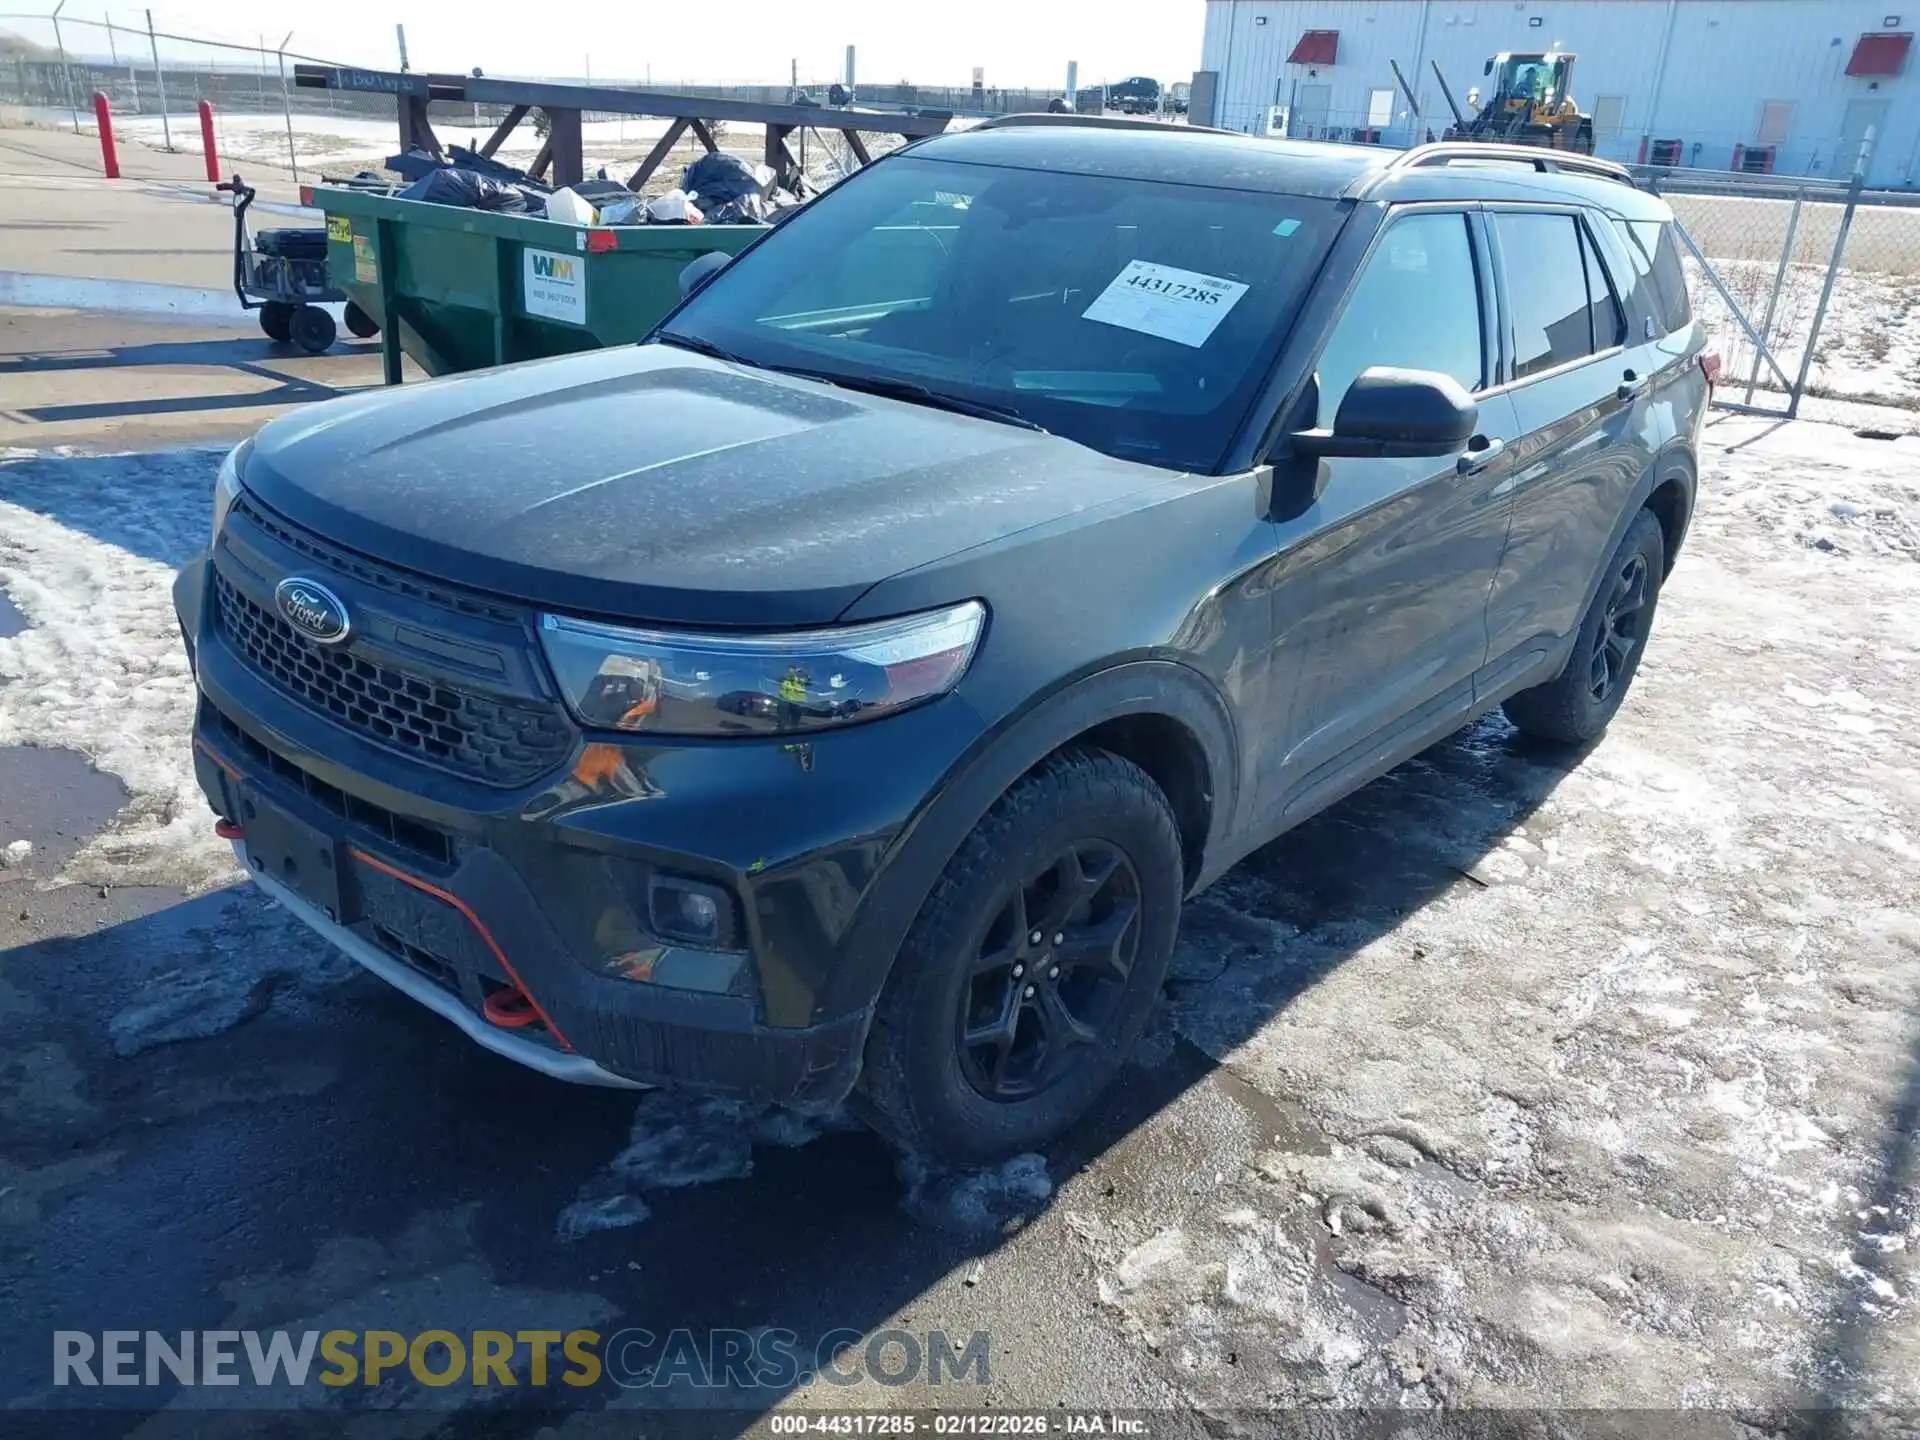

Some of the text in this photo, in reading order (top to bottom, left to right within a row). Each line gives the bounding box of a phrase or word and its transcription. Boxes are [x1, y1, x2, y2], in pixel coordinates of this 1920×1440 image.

[532, 254, 575, 281] WM
[1126, 275, 1223, 305] 44317285
[287, 589, 328, 630] Ford
